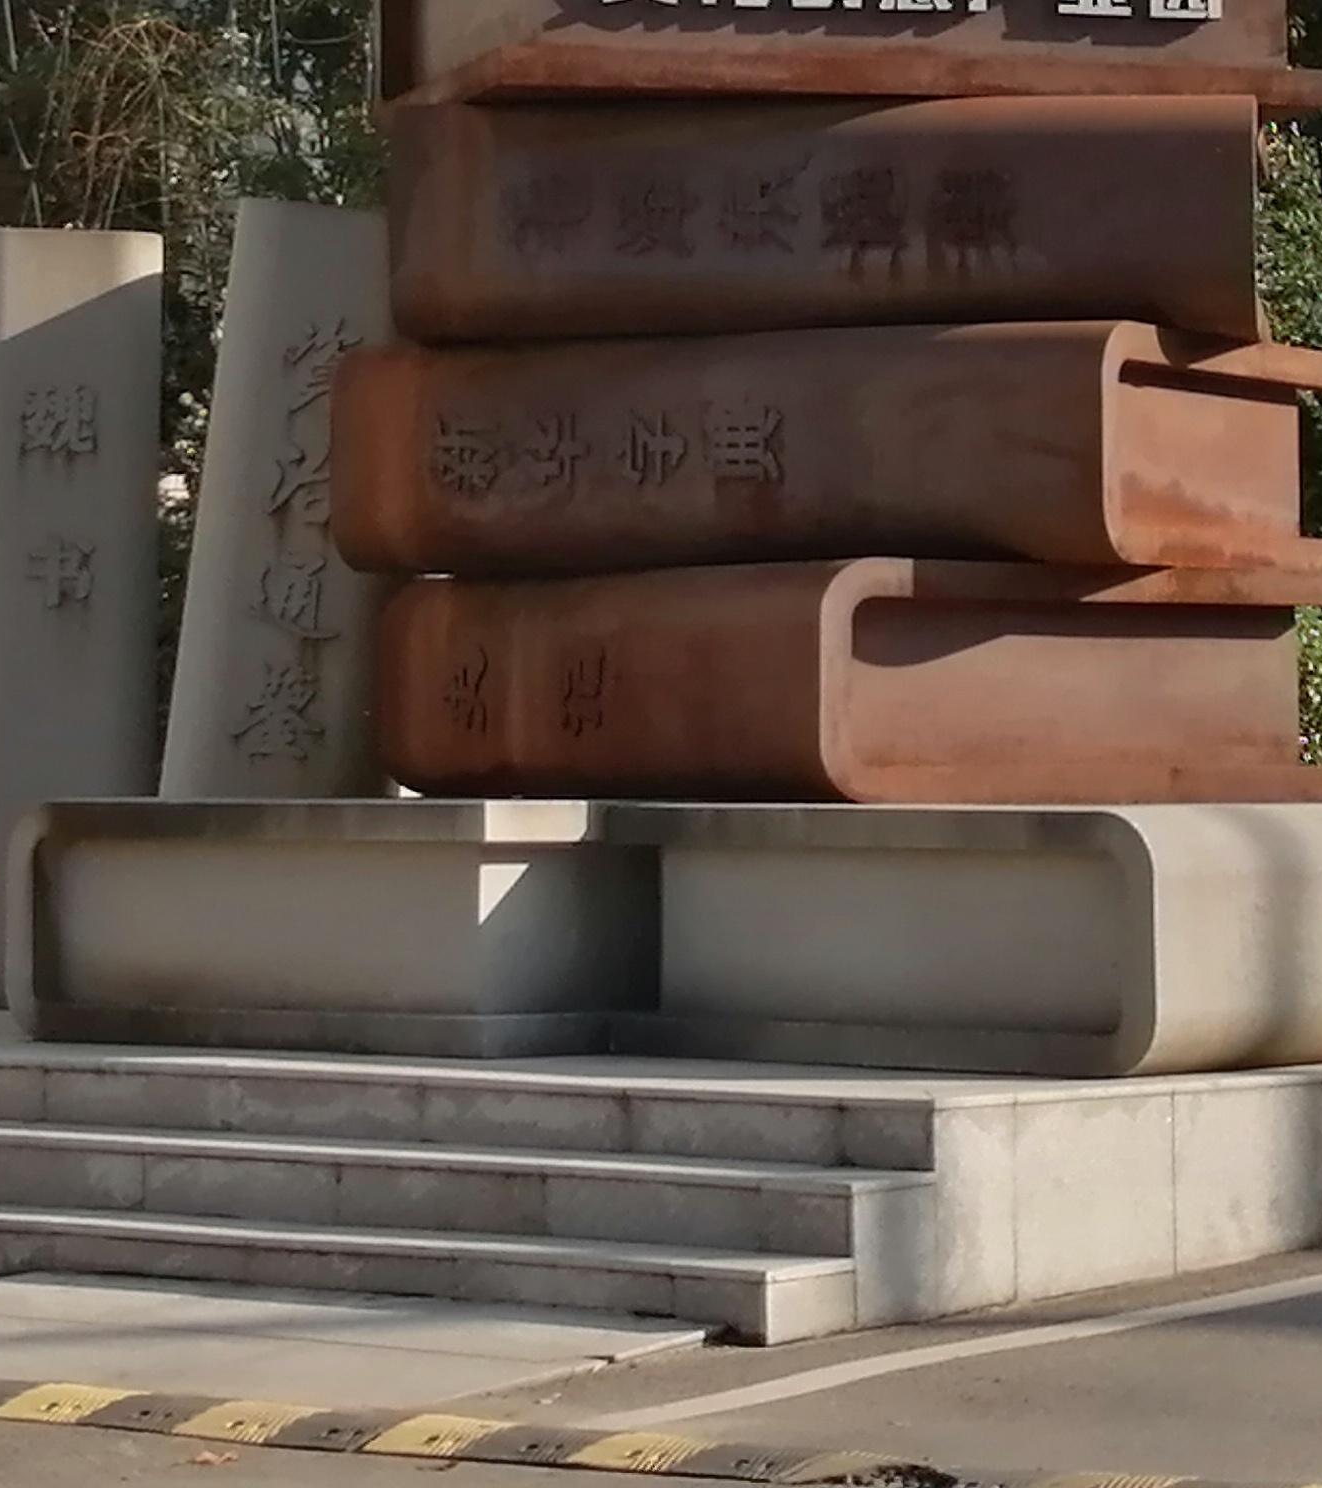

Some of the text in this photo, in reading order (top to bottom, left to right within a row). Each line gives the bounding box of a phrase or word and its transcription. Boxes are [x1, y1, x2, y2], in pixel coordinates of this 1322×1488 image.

[20, 385, 98, 609] 魏书
[435, 410, 784, 489] 新华字典
